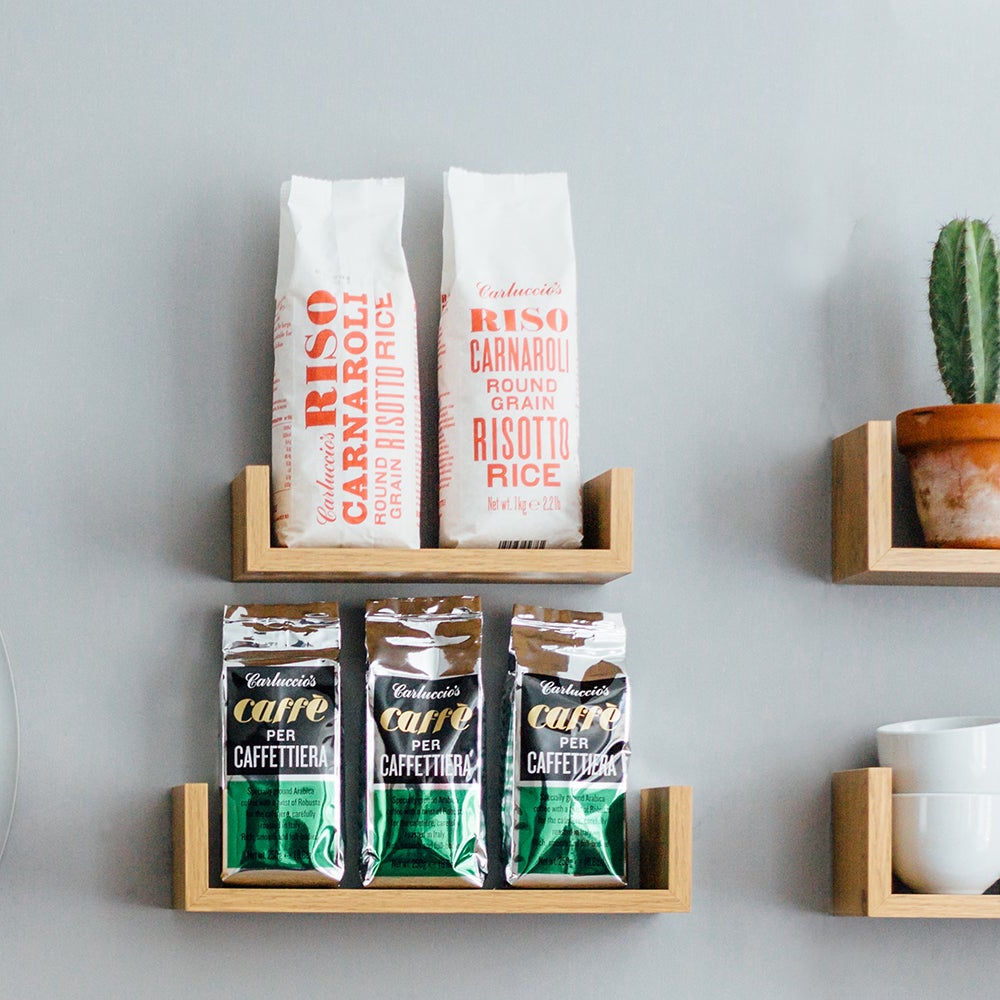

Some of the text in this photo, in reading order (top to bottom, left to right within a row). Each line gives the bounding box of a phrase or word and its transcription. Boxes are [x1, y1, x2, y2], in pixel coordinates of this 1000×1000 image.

[476, 282, 562, 300] Carluccio's
[470, 308, 569, 333] RISO
[470, 337, 569, 374] CARNAROLI
[375, 292, 405, 450] RISOTTO RICE
[487, 378, 557, 393] ROUND
[305, 290, 338, 526] Carluccio's RISO
[342, 292, 368, 525] CARNAROLI
[491, 396, 554, 411] GRAIN
[473, 416, 570, 462] RISOTTO
[487, 463, 561, 488] RICE
[375, 457, 387, 525] ROUND
[390, 459, 402, 519] GRAIN
[487, 496, 499, 511] Net
[245, 671, 317, 689] Carluccio's
[392, 682, 460, 700] Carluccio's
[540, 680, 610, 697] Carluccio's
[233, 693, 329, 724] caffè
[380, 703, 473, 734] caffè
[528, 702, 621, 732] caffè
[266, 730, 296, 742] PER
[411, 739, 441, 751] PER
[560, 737, 589, 749] PER
[234, 745, 328, 769] CAFFETTIERA
[380, 754, 470, 777] CAFFETTIERA
[527, 751, 617, 776] CAFFETTIERA
